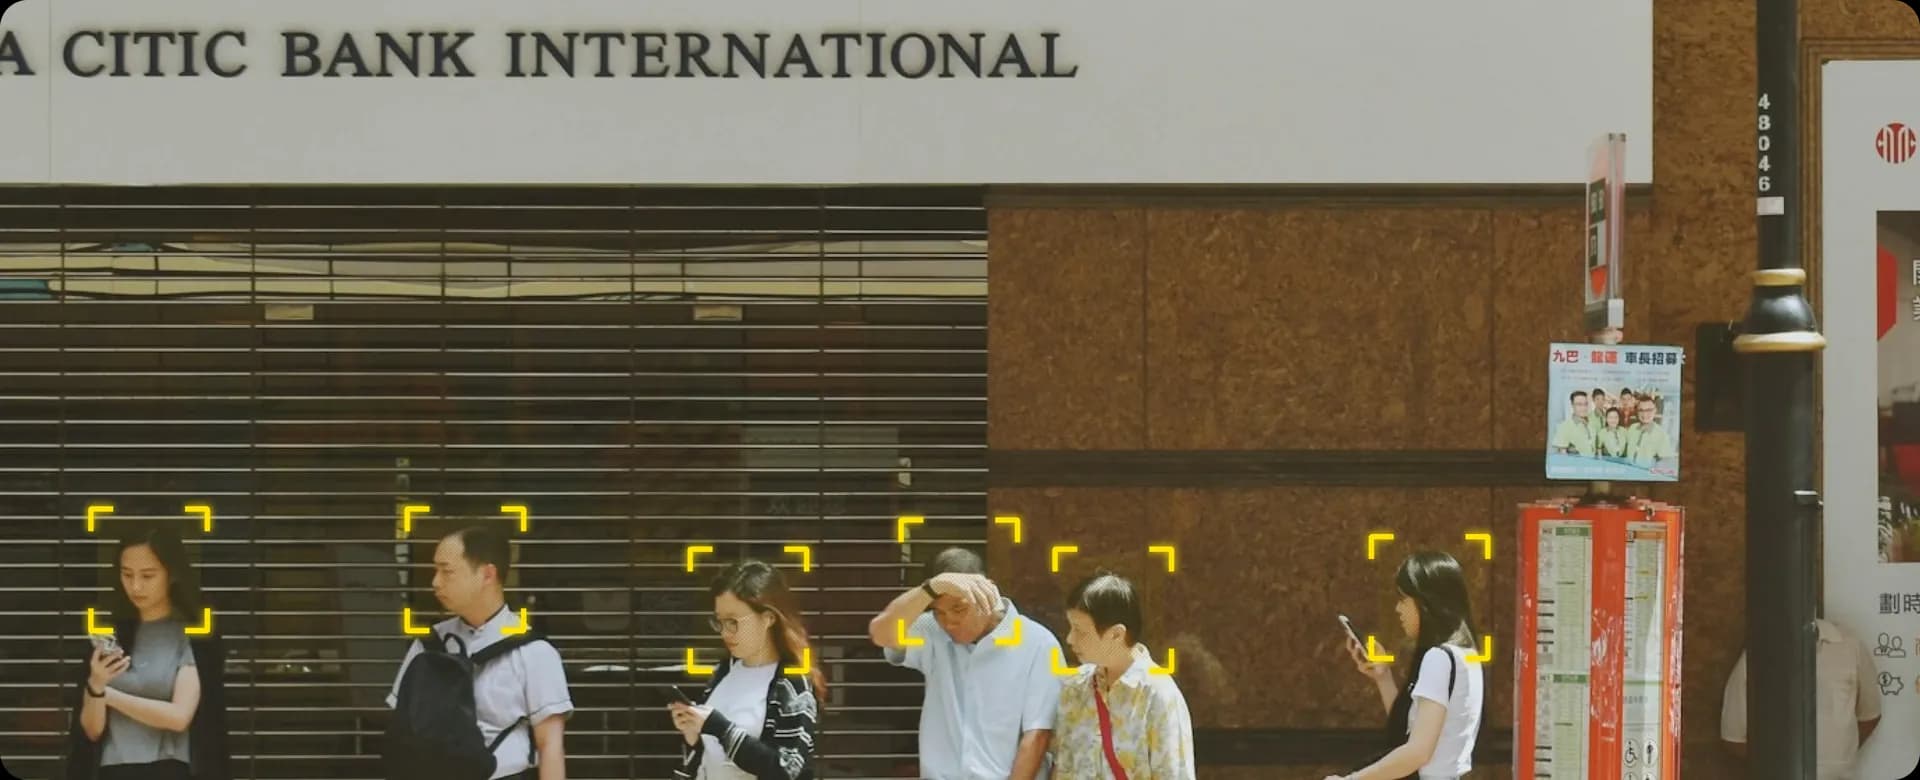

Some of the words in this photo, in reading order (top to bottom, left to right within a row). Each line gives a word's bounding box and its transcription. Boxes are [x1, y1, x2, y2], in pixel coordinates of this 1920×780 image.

[0, 31, 36, 76] A
[62, 30, 247, 78] CITIC
[280, 31, 475, 78] BANK
[504, 31, 1078, 79] INTERNATIONAL
[1758, 93, 1771, 192] 48046
[1552, 350, 1579, 363] 九巴
[1879, 592, 1920, 614] 劃時
